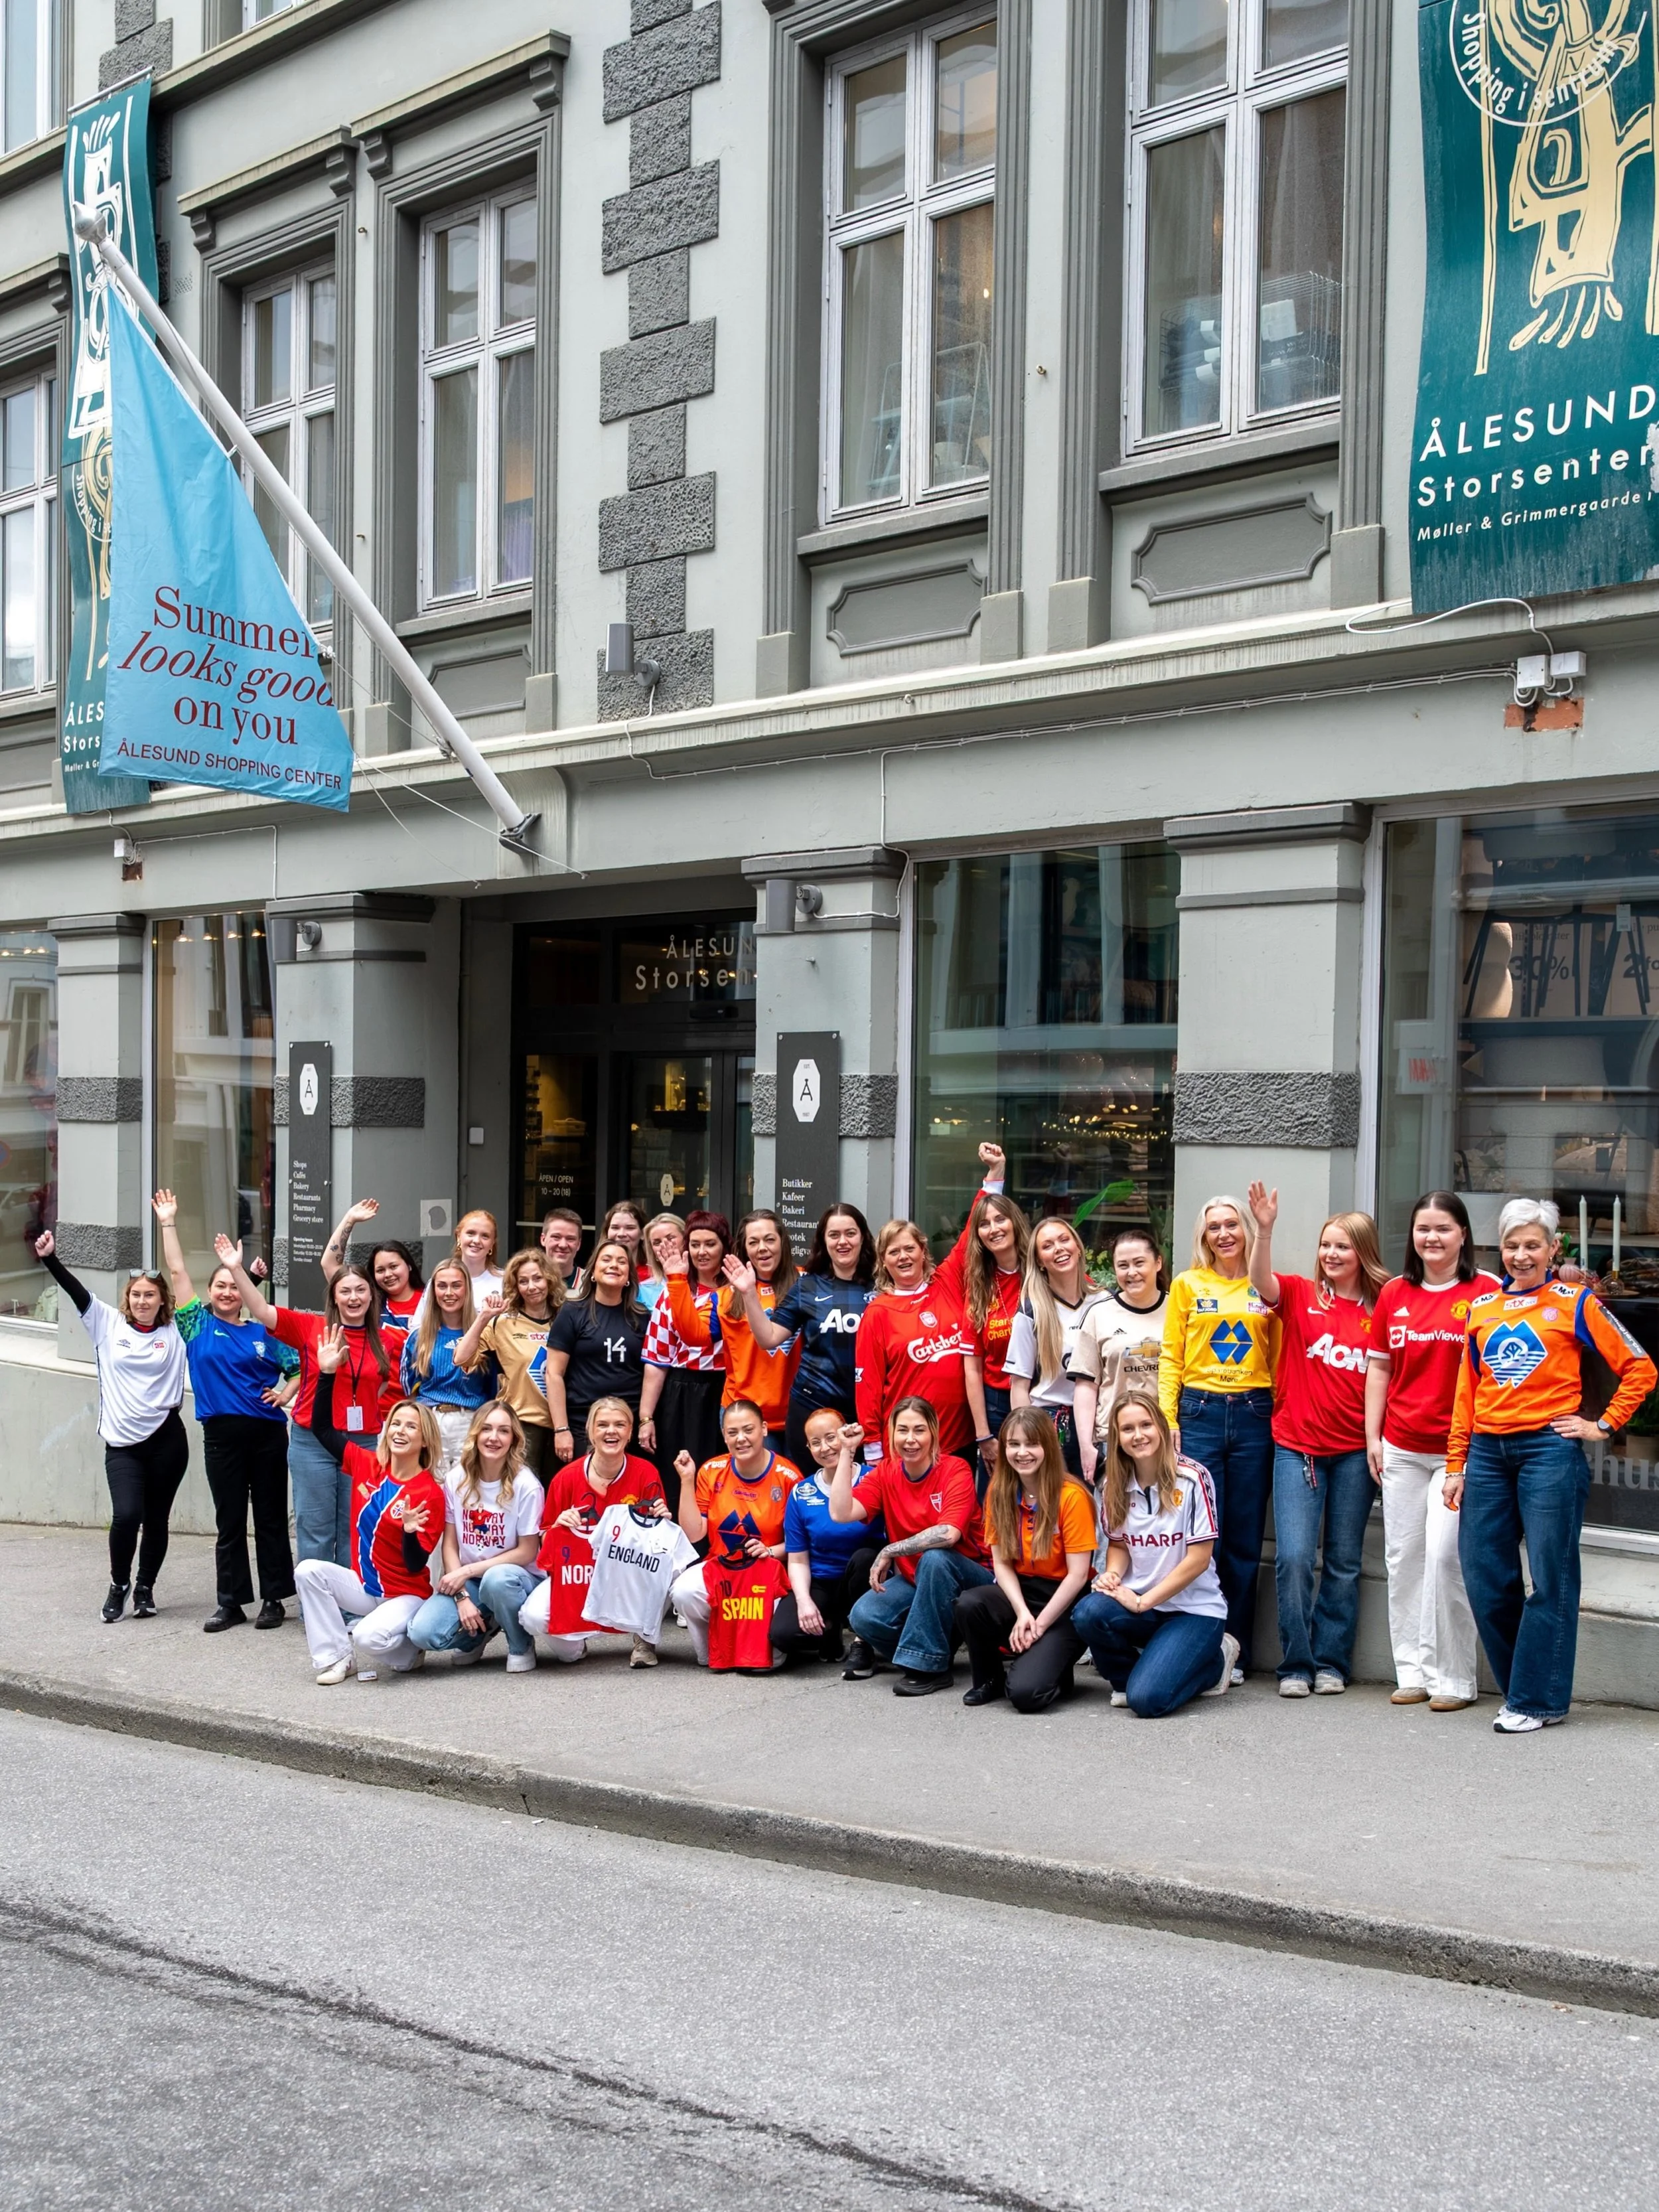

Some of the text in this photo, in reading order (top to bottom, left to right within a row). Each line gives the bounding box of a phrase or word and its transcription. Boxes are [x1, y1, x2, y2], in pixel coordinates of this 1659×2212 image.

[1460, 12, 1514, 115] Shopping
[1533, 39, 1619, 111] sentrum
[1419, 384, 1657, 462] ÅLESUND
[1417, 443, 1652, 507] Storsenter
[76, 473, 98, 534] Shopping
[1417, 522, 1472, 541] Møller
[1480, 516, 1492, 530] &
[117, 630, 238, 687] looks
[174, 696, 298, 745] on you
[117, 738, 342, 790] ÅLESUND SHOPPING CENTER
[293, 1182, 309, 1192] Bakery
[782, 1179, 813, 1188] Butikker
[293, 1193, 321, 1201] Restaurants
[782, 1192, 806, 1201] Kafeer
[782, 1205, 805, 1215] Bakeri
[819, 1309, 865, 1334] AO
[603, 1336, 627, 1363] 14
[613, 1525, 620, 1542] 9
[562, 1546, 571, 1563] 9
[608, 1544, 660, 1573] ENGLAND
[722, 1597, 764, 1621] SPAIN
